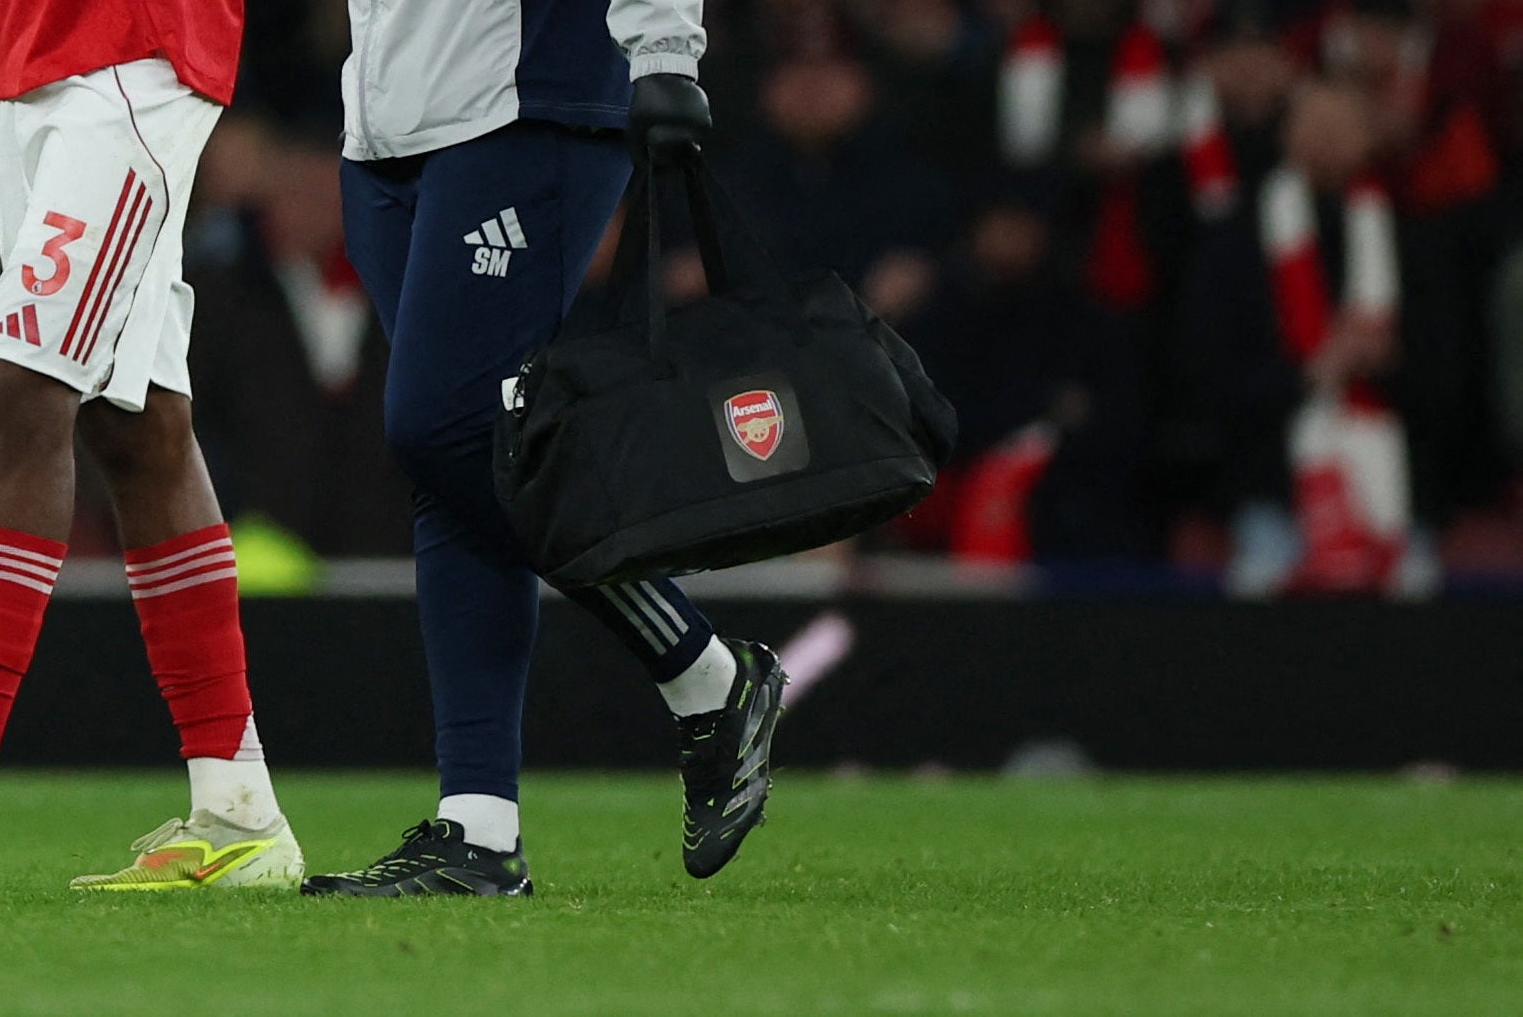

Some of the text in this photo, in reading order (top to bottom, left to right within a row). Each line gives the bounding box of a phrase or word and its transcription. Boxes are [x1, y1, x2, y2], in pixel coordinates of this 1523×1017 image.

[21, 210, 87, 296] 3
[471, 246, 512, 278] SM
[733, 399, 773, 418] Arsenal
